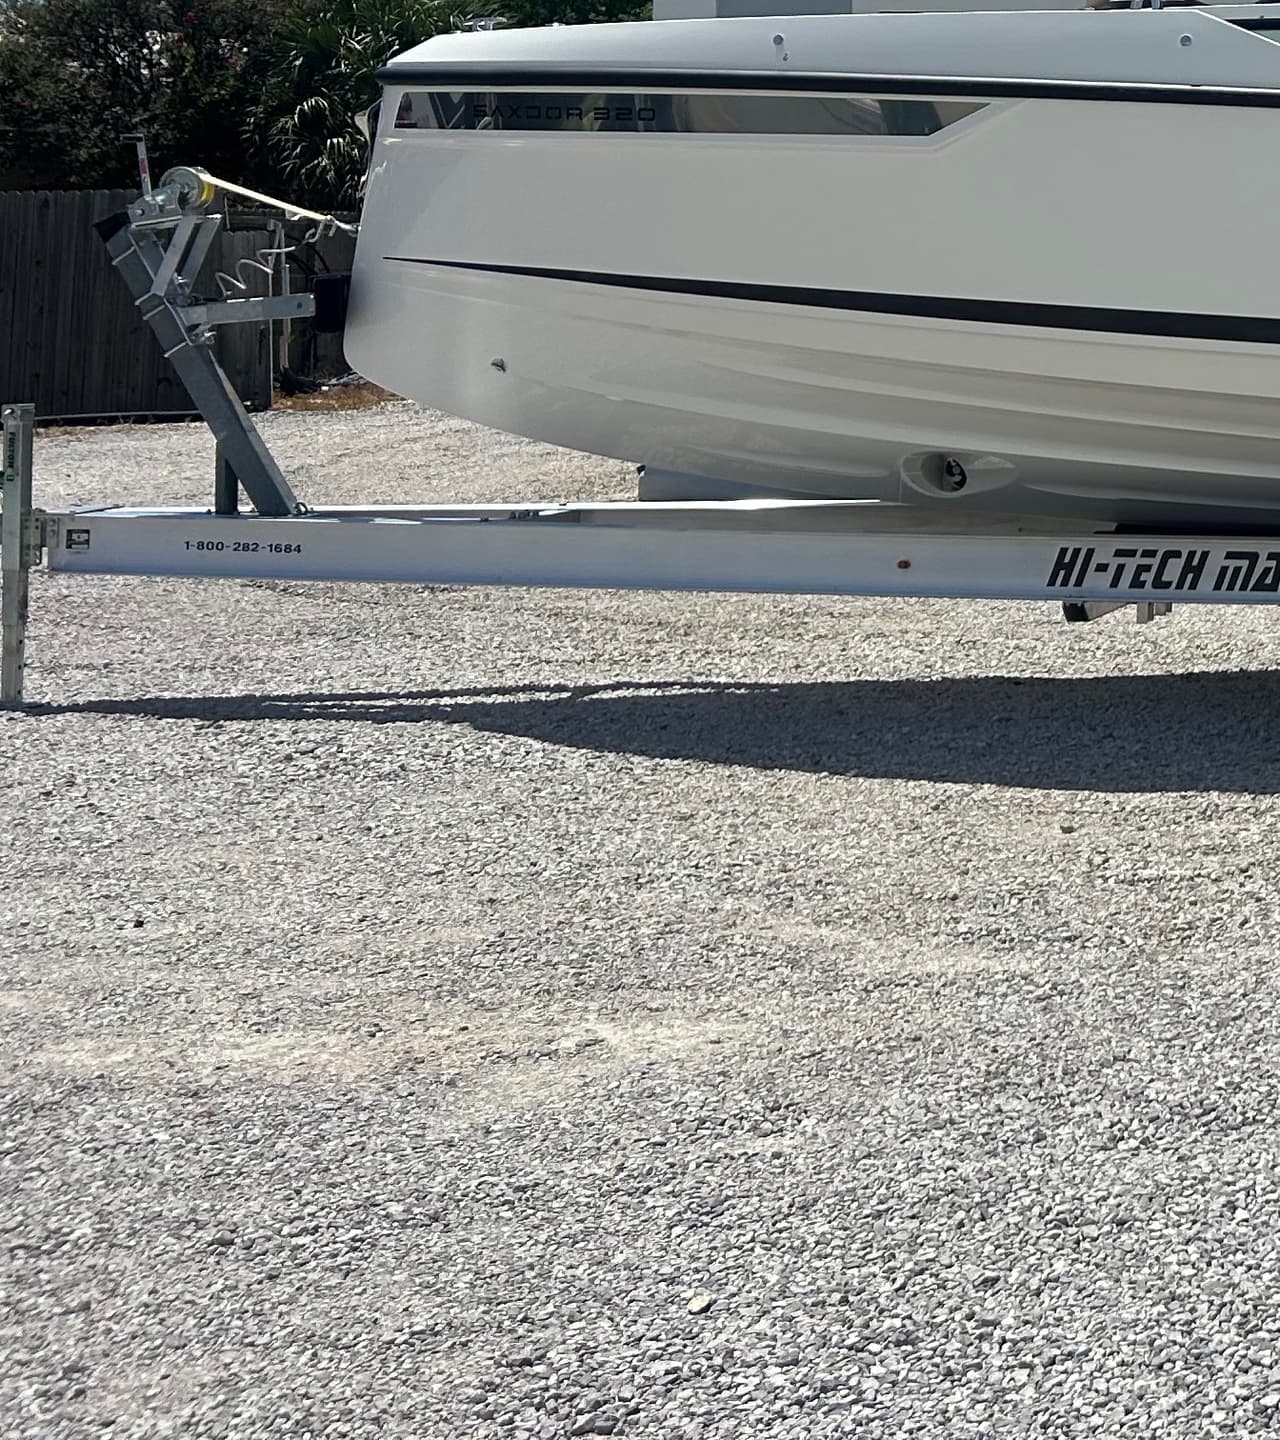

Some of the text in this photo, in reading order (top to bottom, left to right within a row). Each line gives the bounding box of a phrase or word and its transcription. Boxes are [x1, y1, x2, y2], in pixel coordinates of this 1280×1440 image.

[472, 104, 656, 122] SAXDOR 320
[183, 539, 303, 556] 1-800-282-1684
[1046, 546, 1211, 591] HI-TECH
